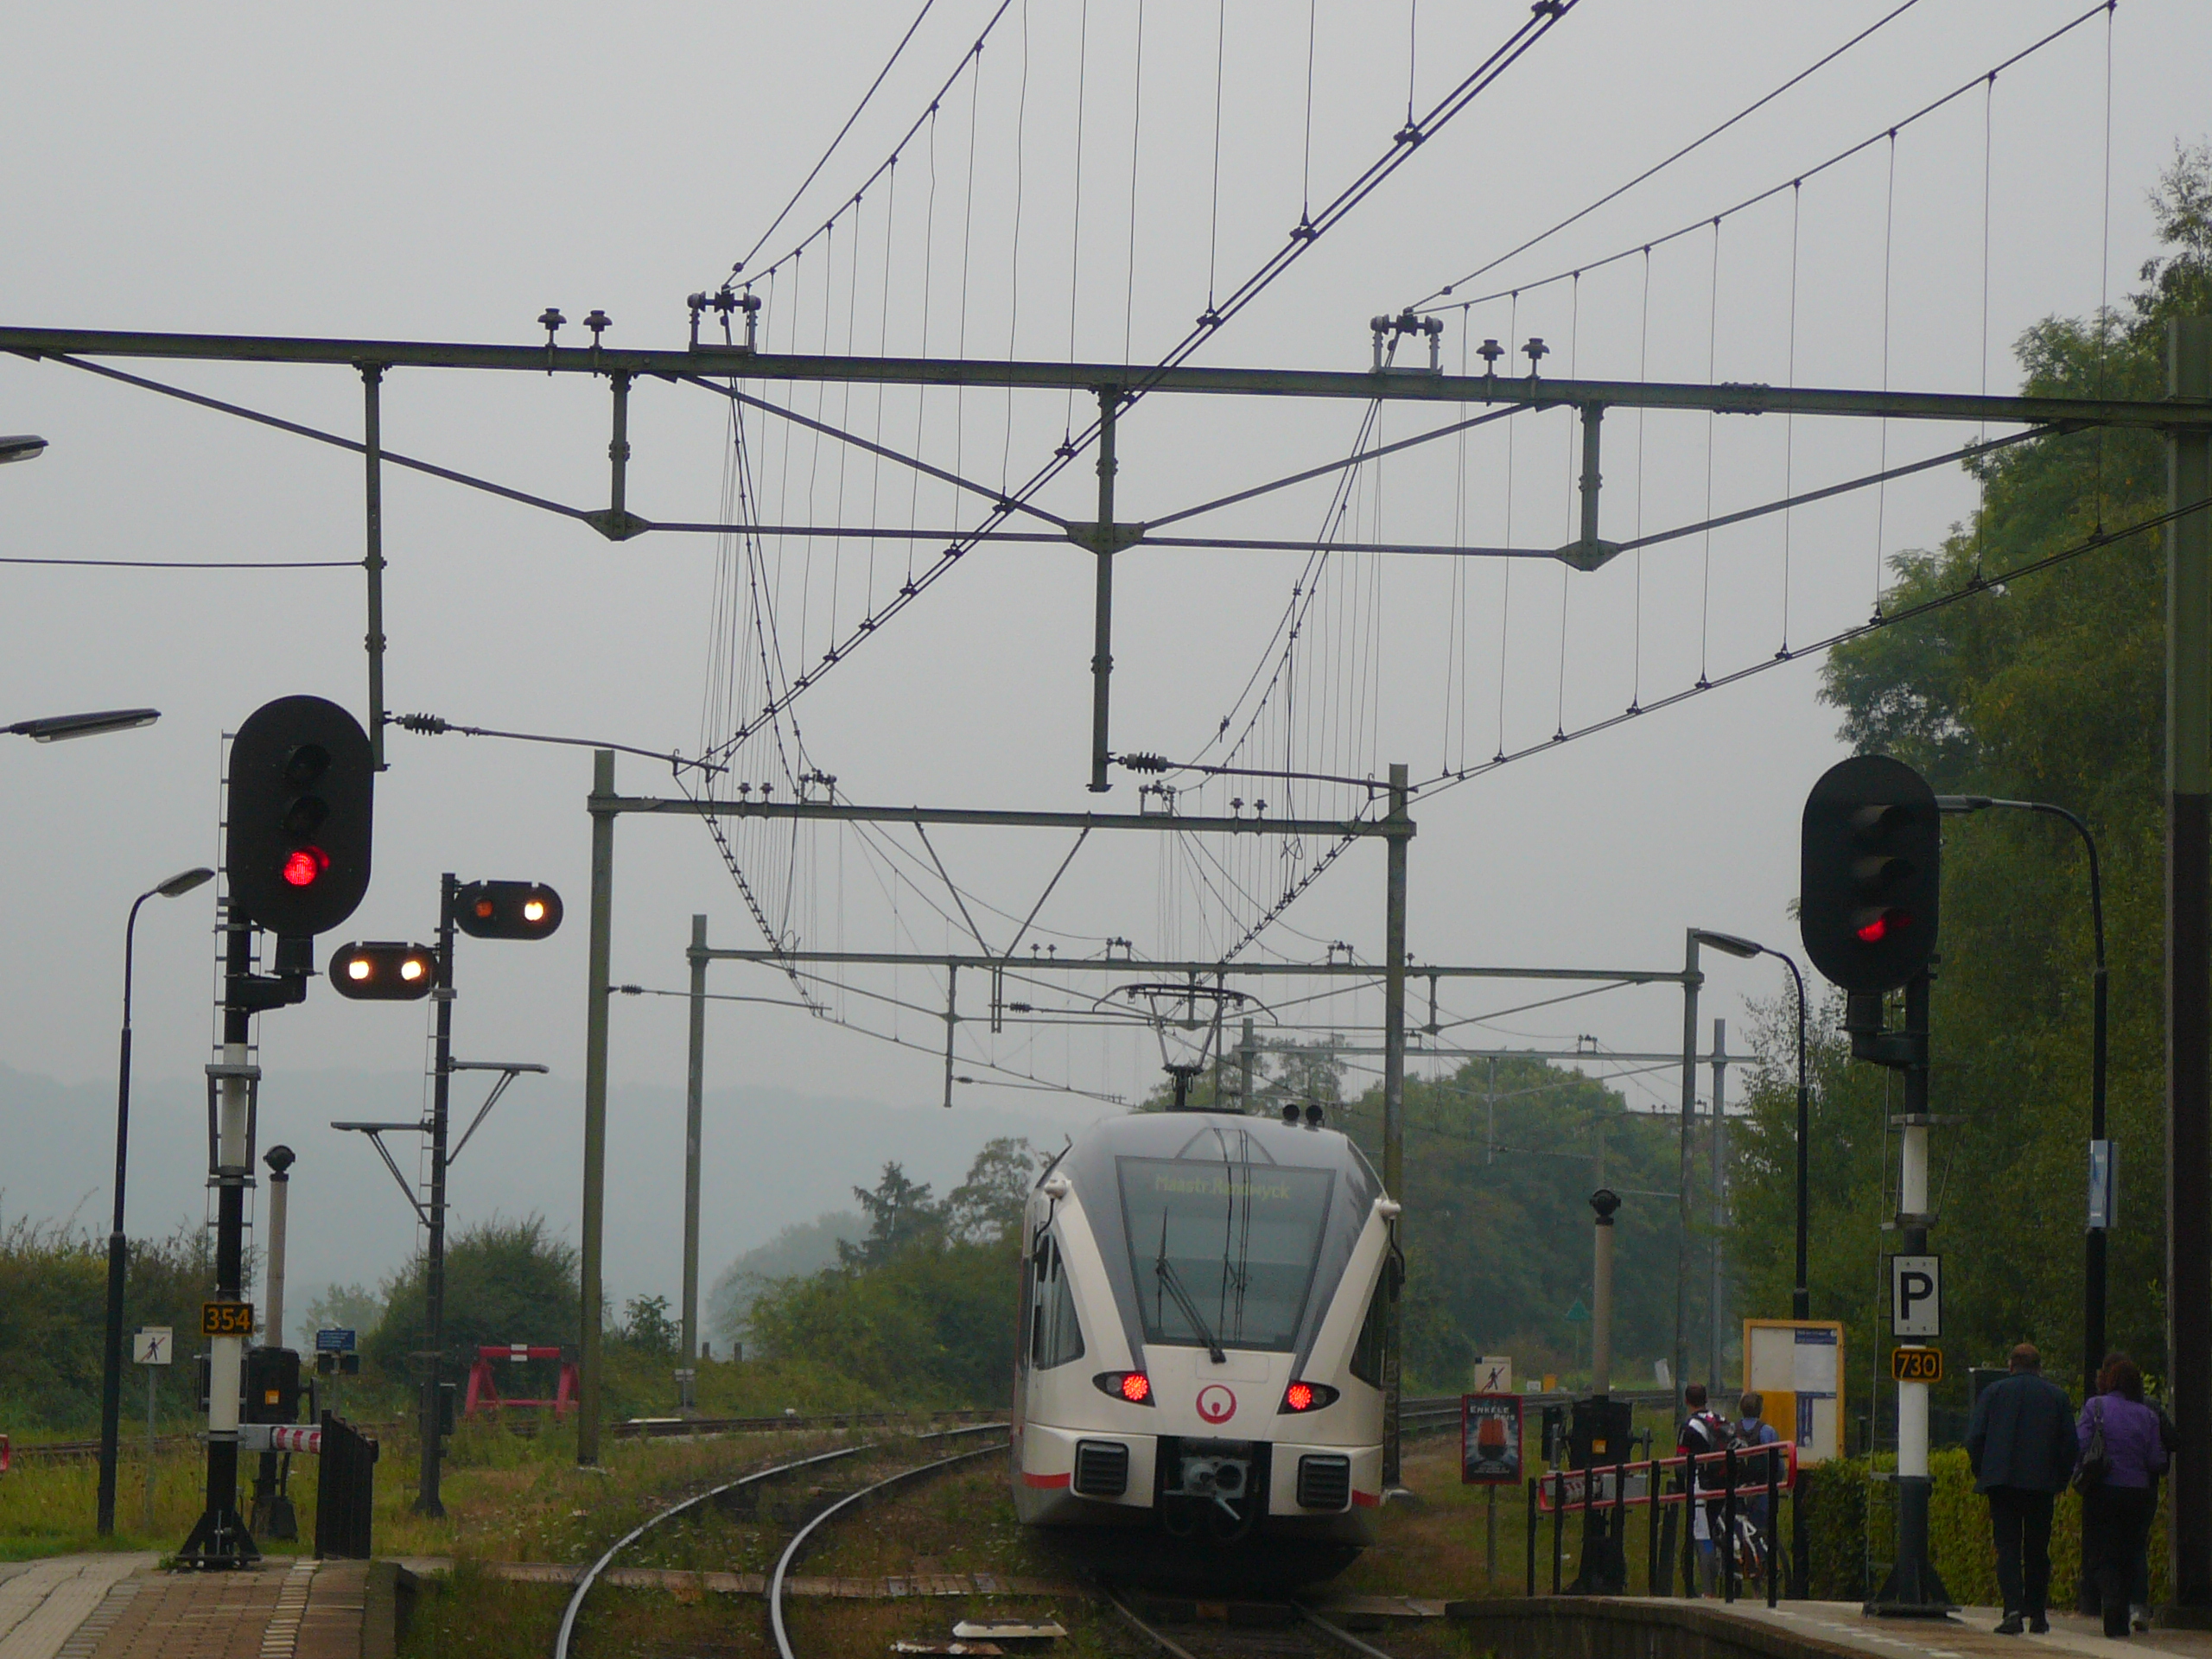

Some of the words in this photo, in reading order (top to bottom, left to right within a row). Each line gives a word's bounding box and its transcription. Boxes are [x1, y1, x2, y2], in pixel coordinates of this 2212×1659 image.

[1900, 1271, 1934, 1320] P
[207, 1306, 251, 1331] 354
[1898, 1354, 1937, 1378] 730
